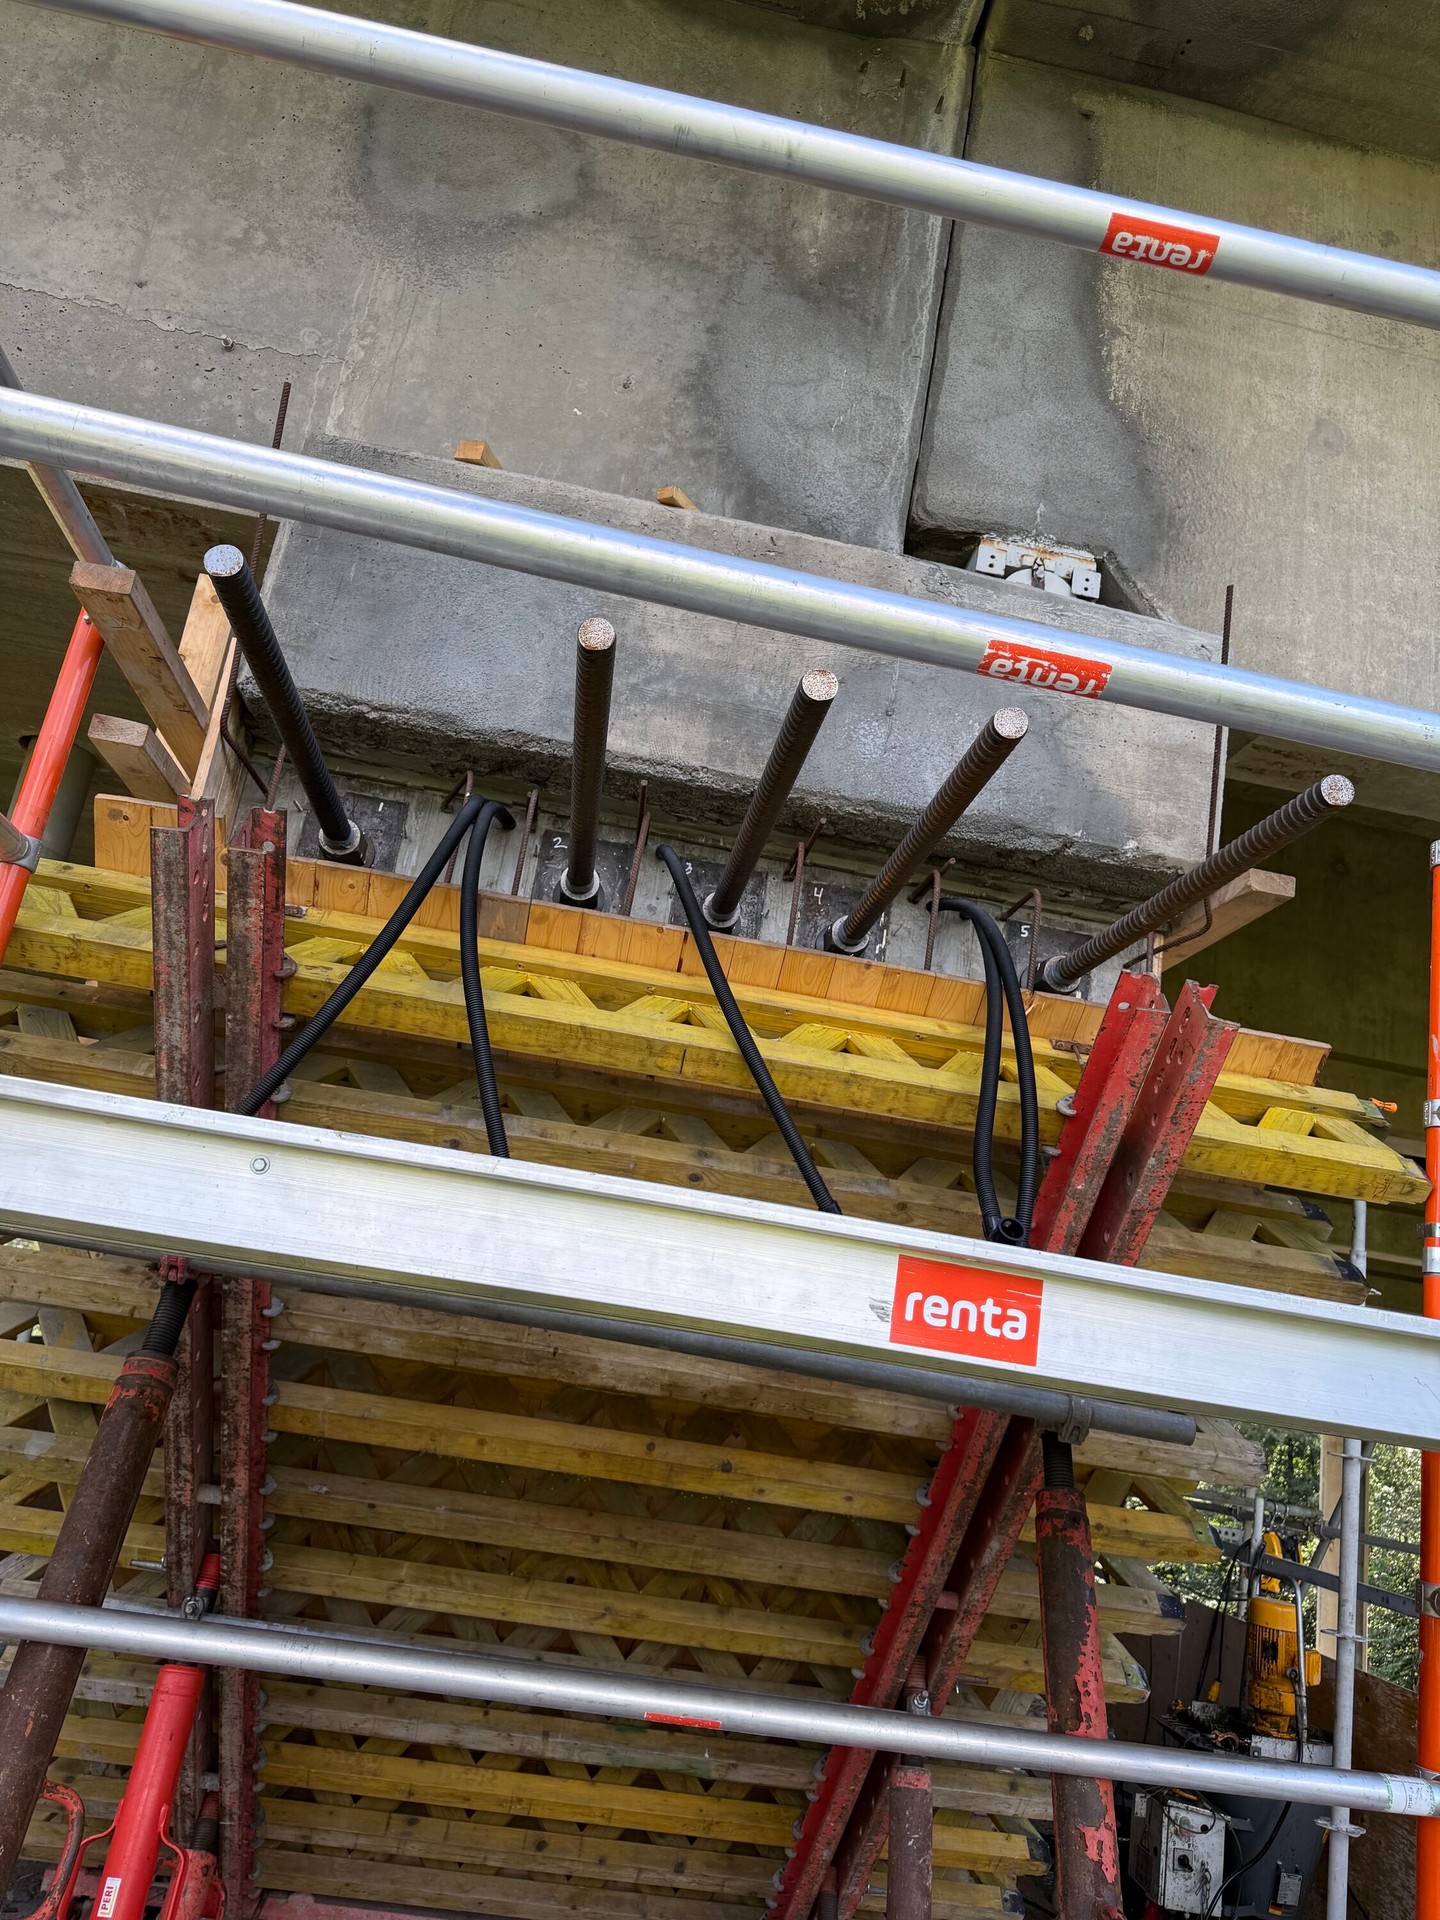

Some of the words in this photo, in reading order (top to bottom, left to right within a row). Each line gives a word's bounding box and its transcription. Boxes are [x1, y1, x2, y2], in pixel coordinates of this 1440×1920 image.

[1111, 230, 1207, 269] renta
[988, 658, 1096, 695] renta
[552, 836, 568, 849] 2
[684, 862, 693, 875] 3
[813, 887, 824, 905] 4
[1020, 925, 1031, 938] 5
[904, 1291, 1028, 1341] renta
[101, 1886, 114, 1911] PERI
